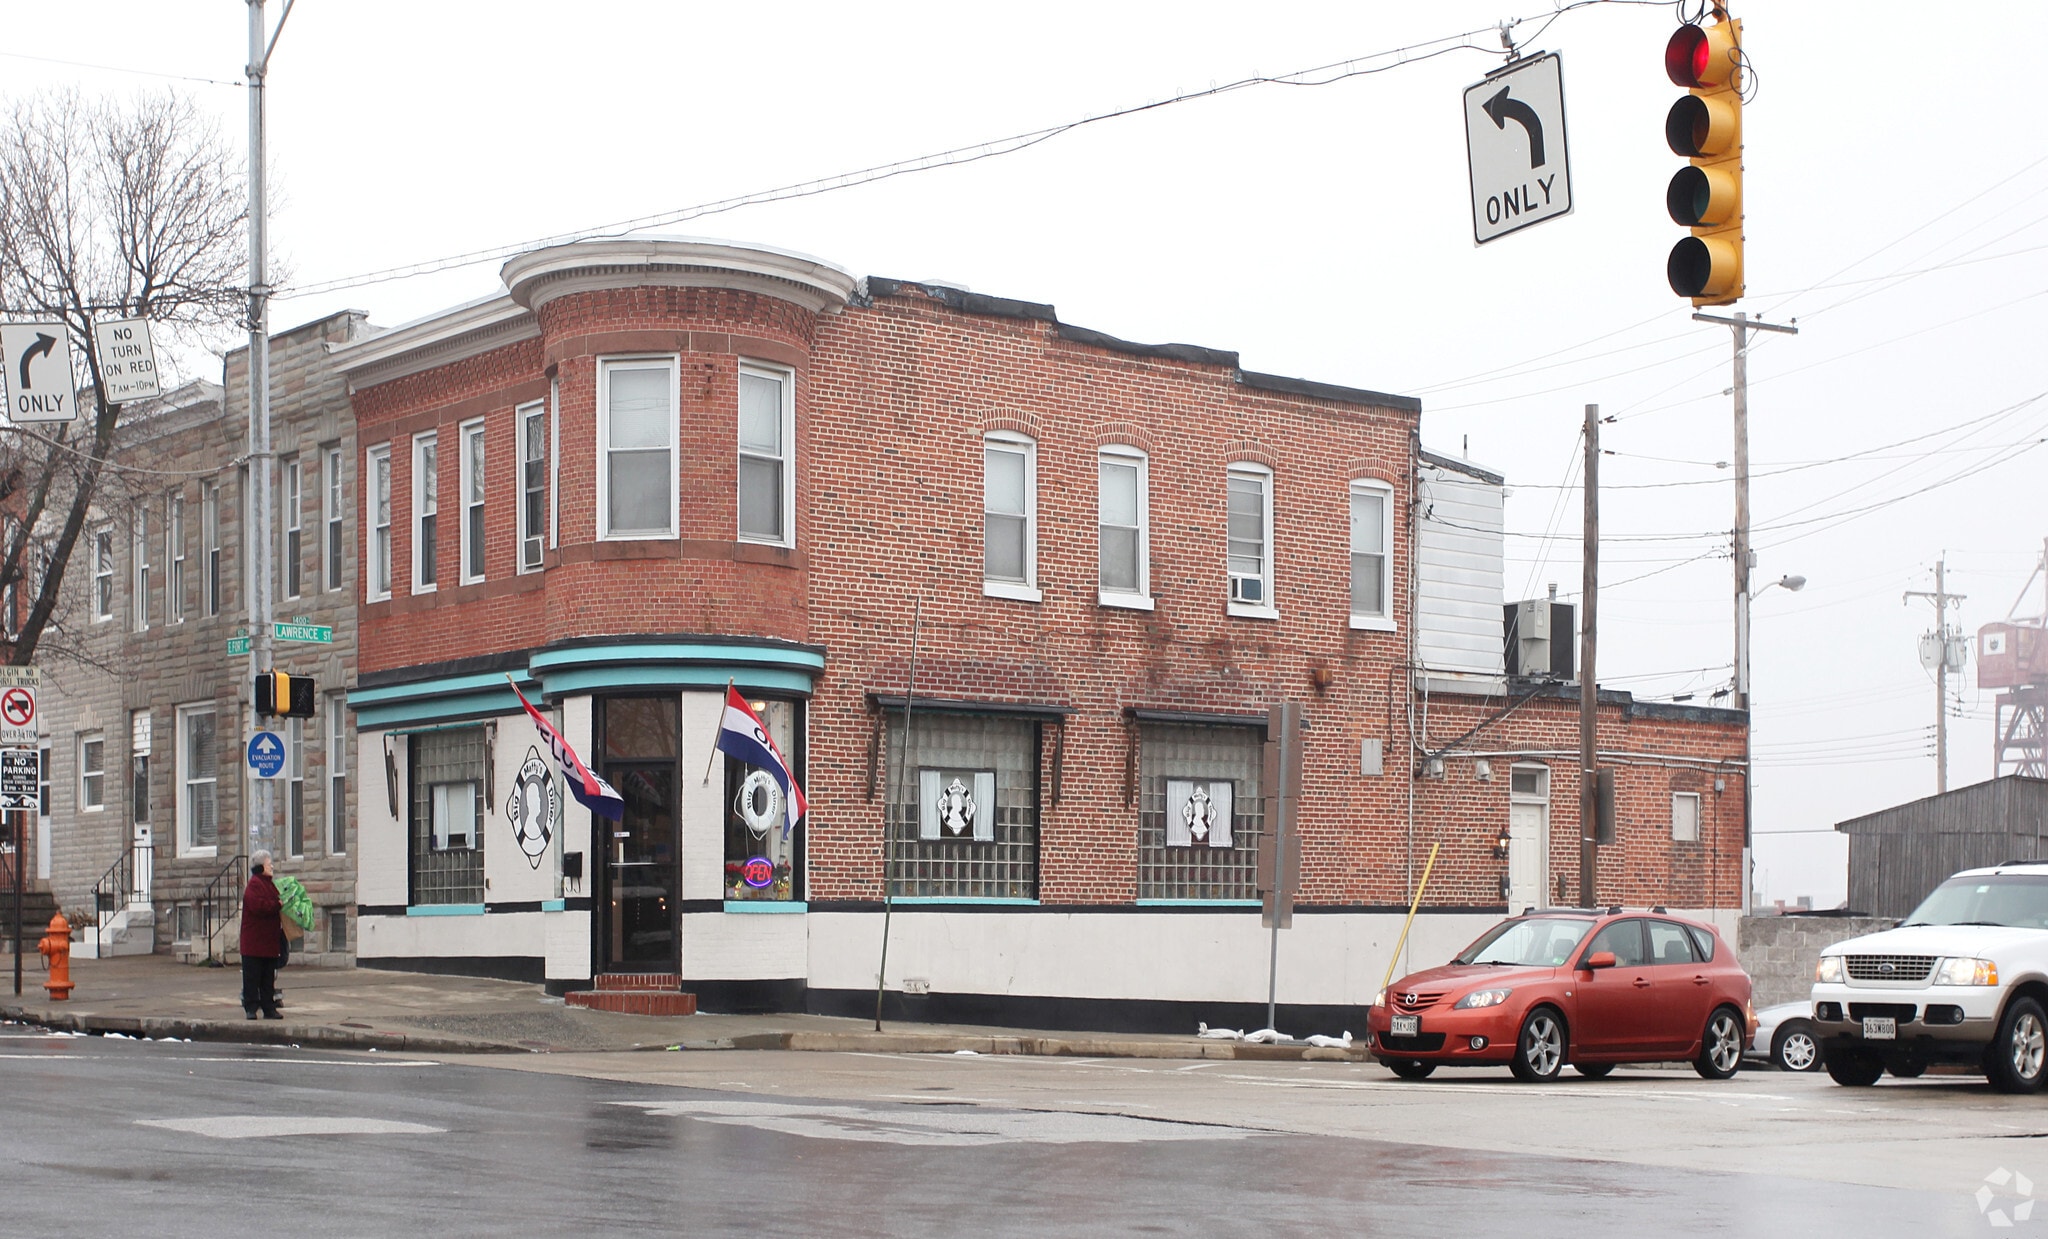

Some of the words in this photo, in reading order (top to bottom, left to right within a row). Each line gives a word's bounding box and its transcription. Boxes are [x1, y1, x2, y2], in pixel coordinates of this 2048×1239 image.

[1486, 173, 1555, 225] ONLY
[113, 328, 132, 341] NO
[111, 344, 142, 359] TURN
[106, 363, 122, 376] ON
[129, 360, 153, 373] RED
[19, 394, 64, 413] ONLY
[275, 625, 318, 640] LAWRENCE
[323, 631, 331, 641] ST
[25, 669, 34, 677] NO
[2, 730, 17, 738] OVER
[26, 730, 37, 738] TON
[14, 758, 27, 766] NO
[3, 766, 37, 775] PARKING
[745, 864, 772, 881] OPEN
